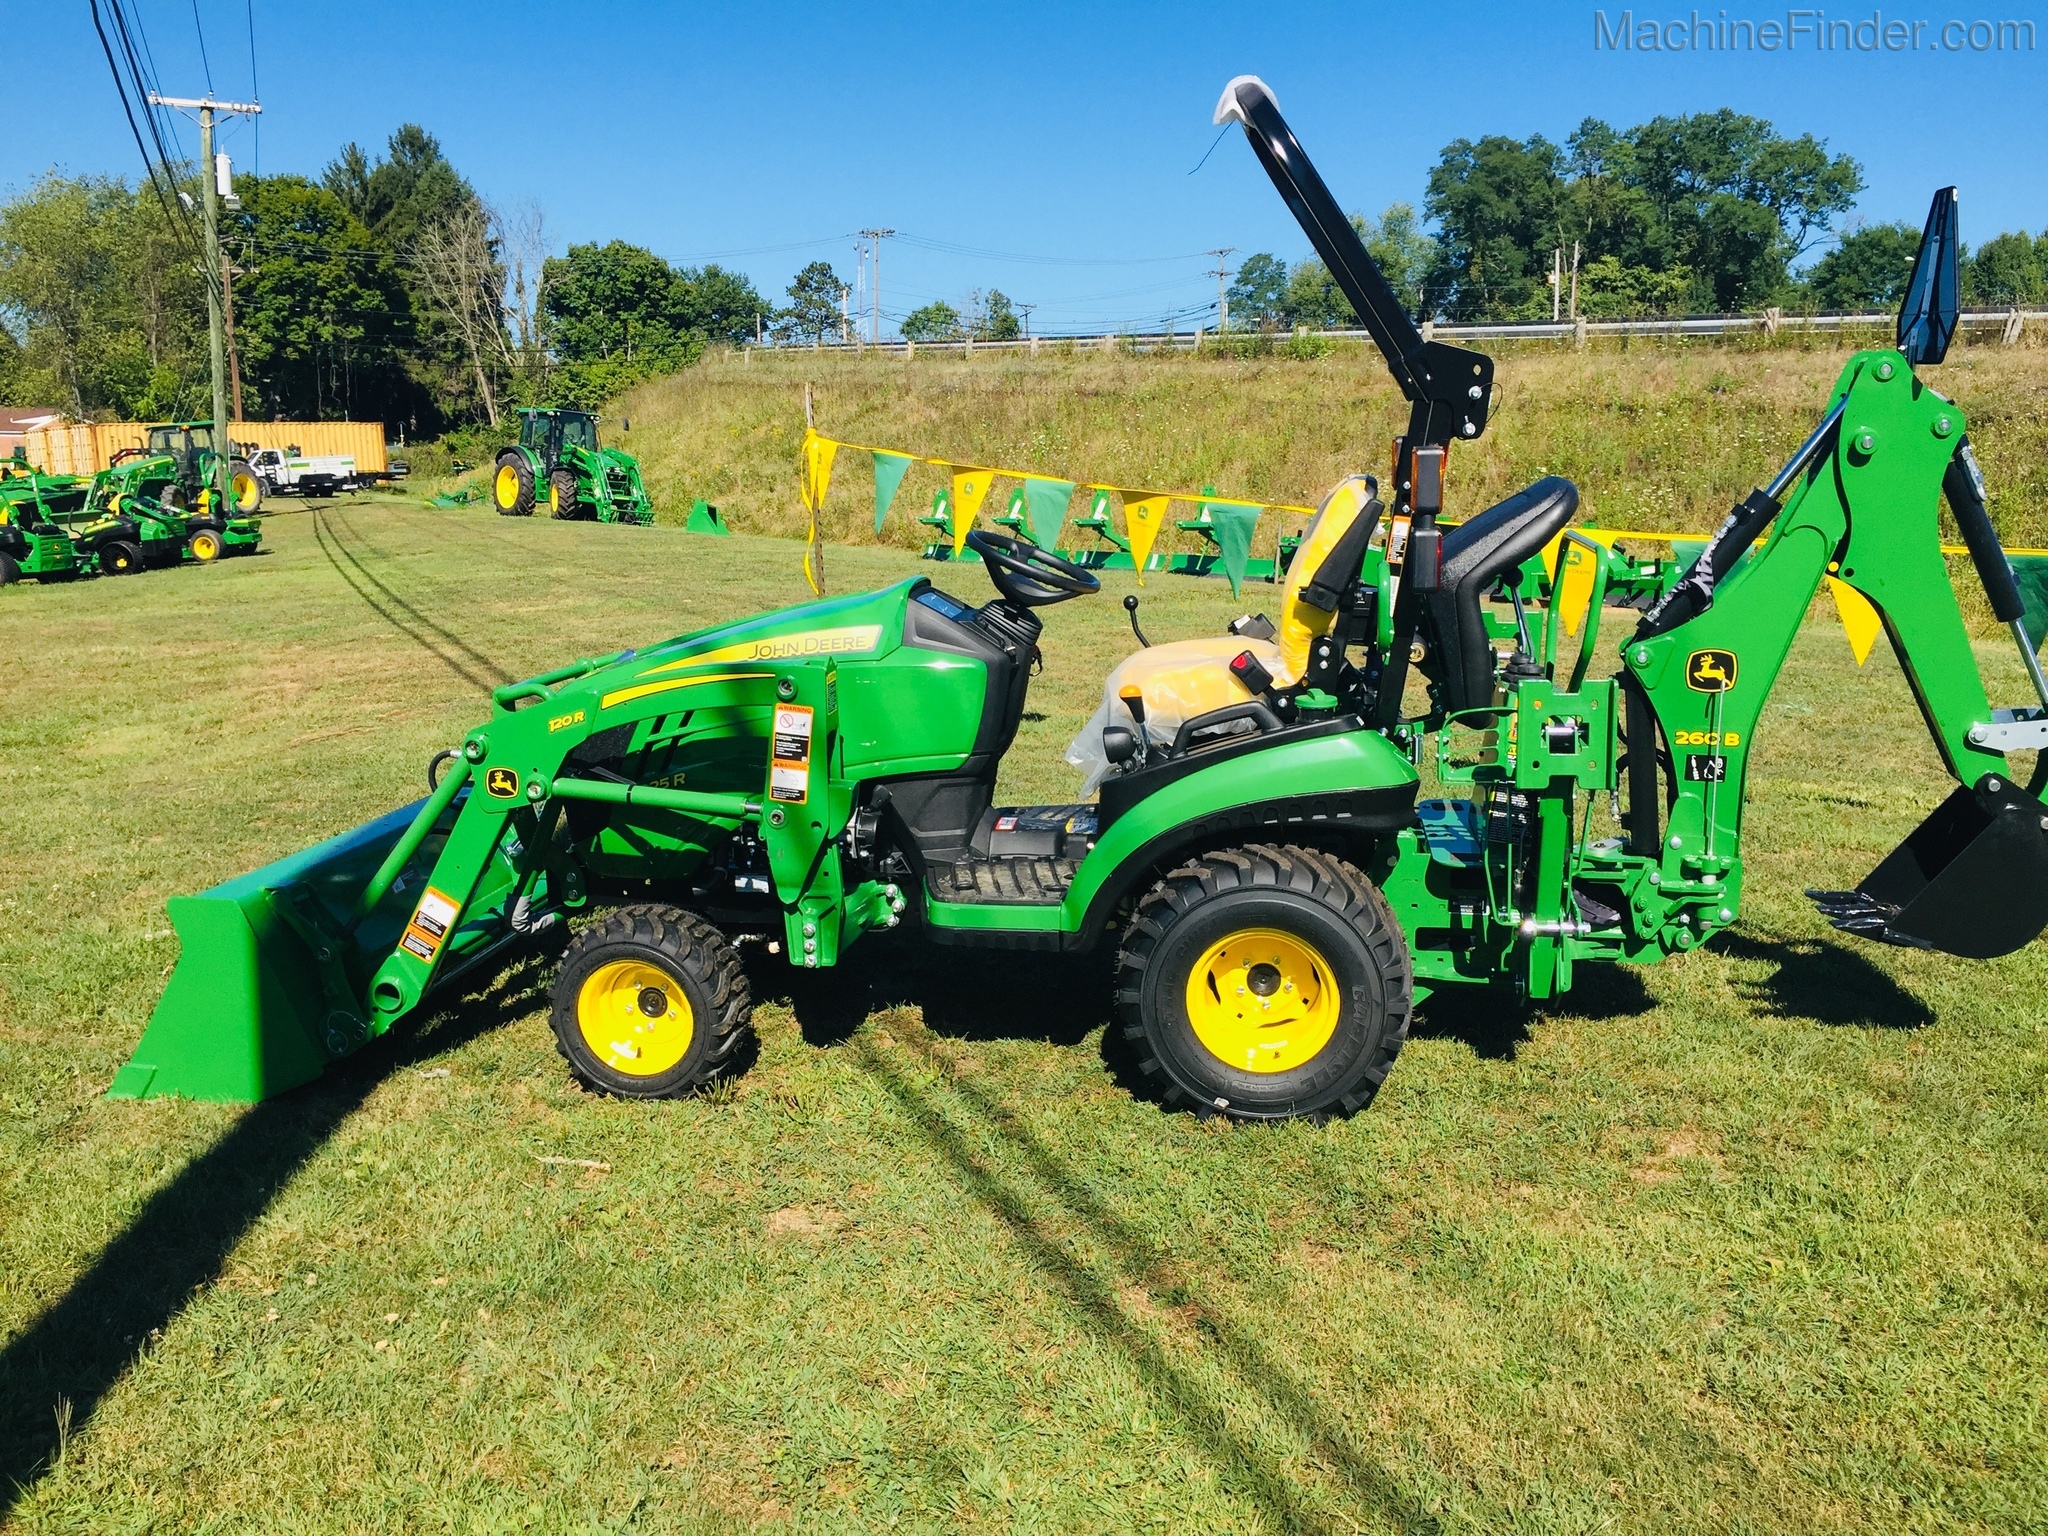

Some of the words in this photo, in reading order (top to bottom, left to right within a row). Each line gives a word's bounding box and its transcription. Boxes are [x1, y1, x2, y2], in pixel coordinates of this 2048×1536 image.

[748, 643, 799, 660] JOHN
[804, 636, 867, 653] DEERE
[783, 705, 812, 714] WARNING
[548, 714, 573, 733] 120
[573, 710, 586, 724] R
[1674, 730, 1721, 746] 260
[1724, 732, 1740, 747] B
[673, 772, 686, 787] R
